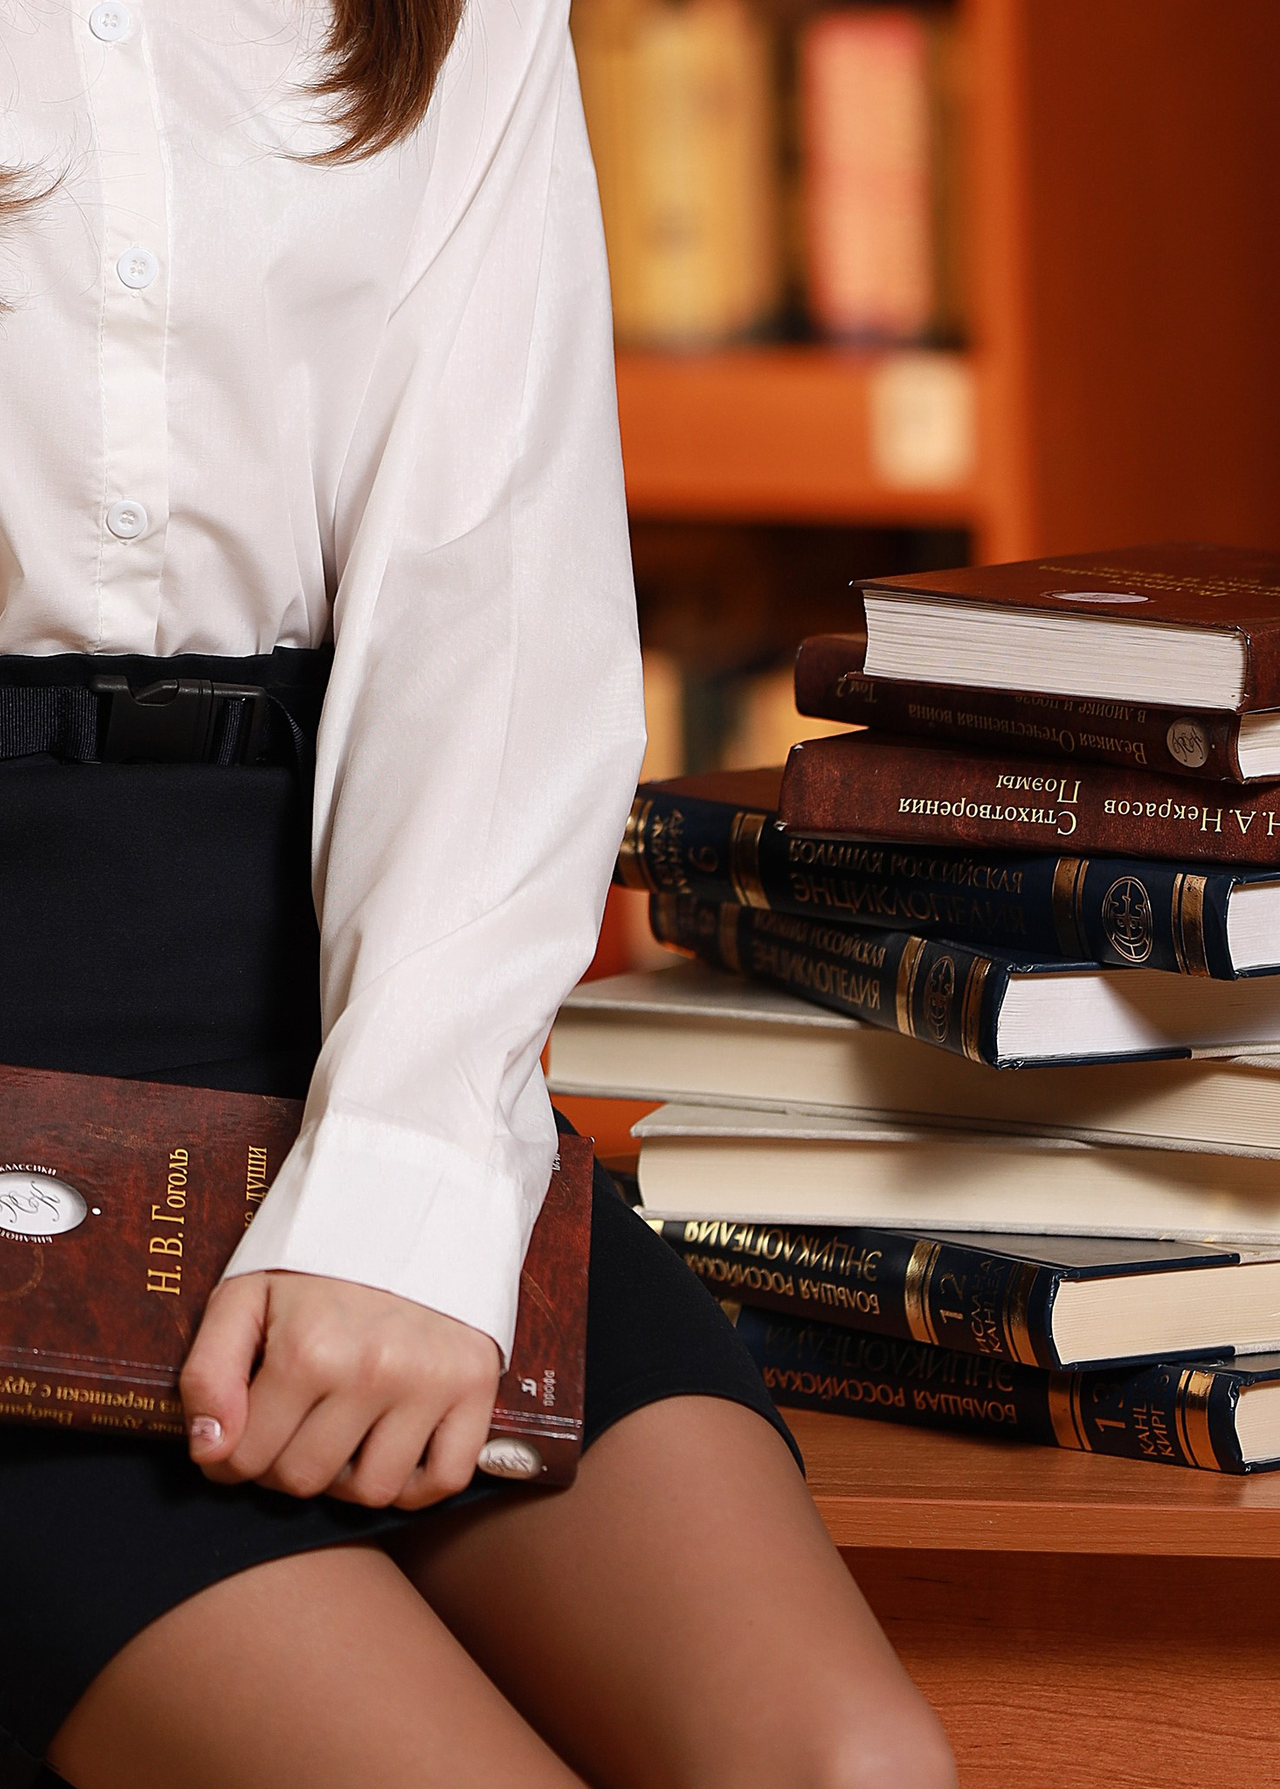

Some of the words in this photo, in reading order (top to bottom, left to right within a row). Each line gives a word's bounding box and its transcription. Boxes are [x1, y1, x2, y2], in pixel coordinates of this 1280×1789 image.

[909, 704, 952, 727] война
[958, 712, 1075, 752] Отечественная
[1080, 732, 1147, 764] Великая
[996, 774, 1081, 803] Поэмы
[899, 797, 1077, 835] Стихотворения
[1104, 799, 1223, 833] Некрасов
[789, 838, 883, 874] БОЛЬШАЯ
[890, 852, 1023, 894] РОССИЙСКАЯ
[790, 872, 1027, 934] ЭНЦИКЛОПЕДИЯ
[151, 1148, 189, 1224] Гоголь
[683, 1221, 883, 1282] ЭНЦИКЛОПЕДИЯ
[683, 1253, 794, 1296] РОССИЙСКАЯ
[799, 1277, 881, 1315] БОЛЬШАЯ
[56, 1385, 154, 1411] переписки
[763, 1366, 905, 1408] РОССИЙСКАЯ
[913, 1389, 1018, 1424] БОЛЬШАЯ
